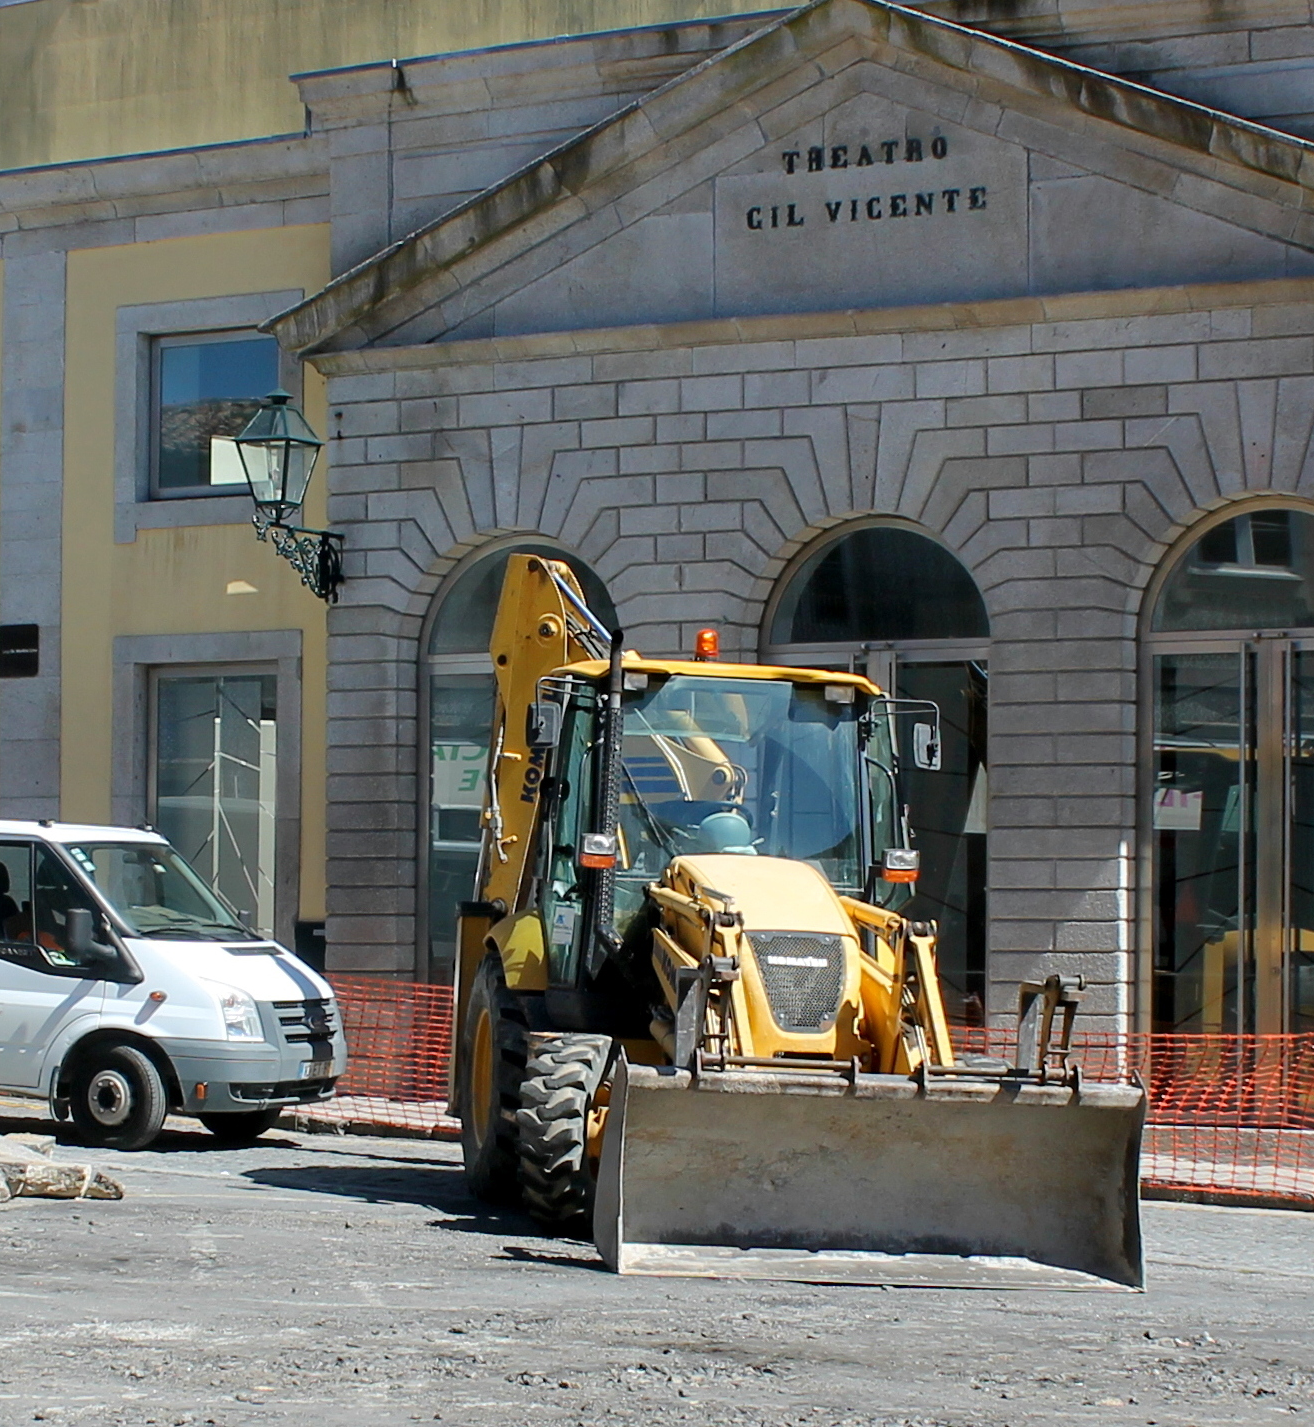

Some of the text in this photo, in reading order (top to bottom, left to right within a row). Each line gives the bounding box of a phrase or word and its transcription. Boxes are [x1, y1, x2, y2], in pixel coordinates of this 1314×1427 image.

[782, 136, 949, 174] THEATRO
[747, 186, 987, 230] GIL VICENTE
